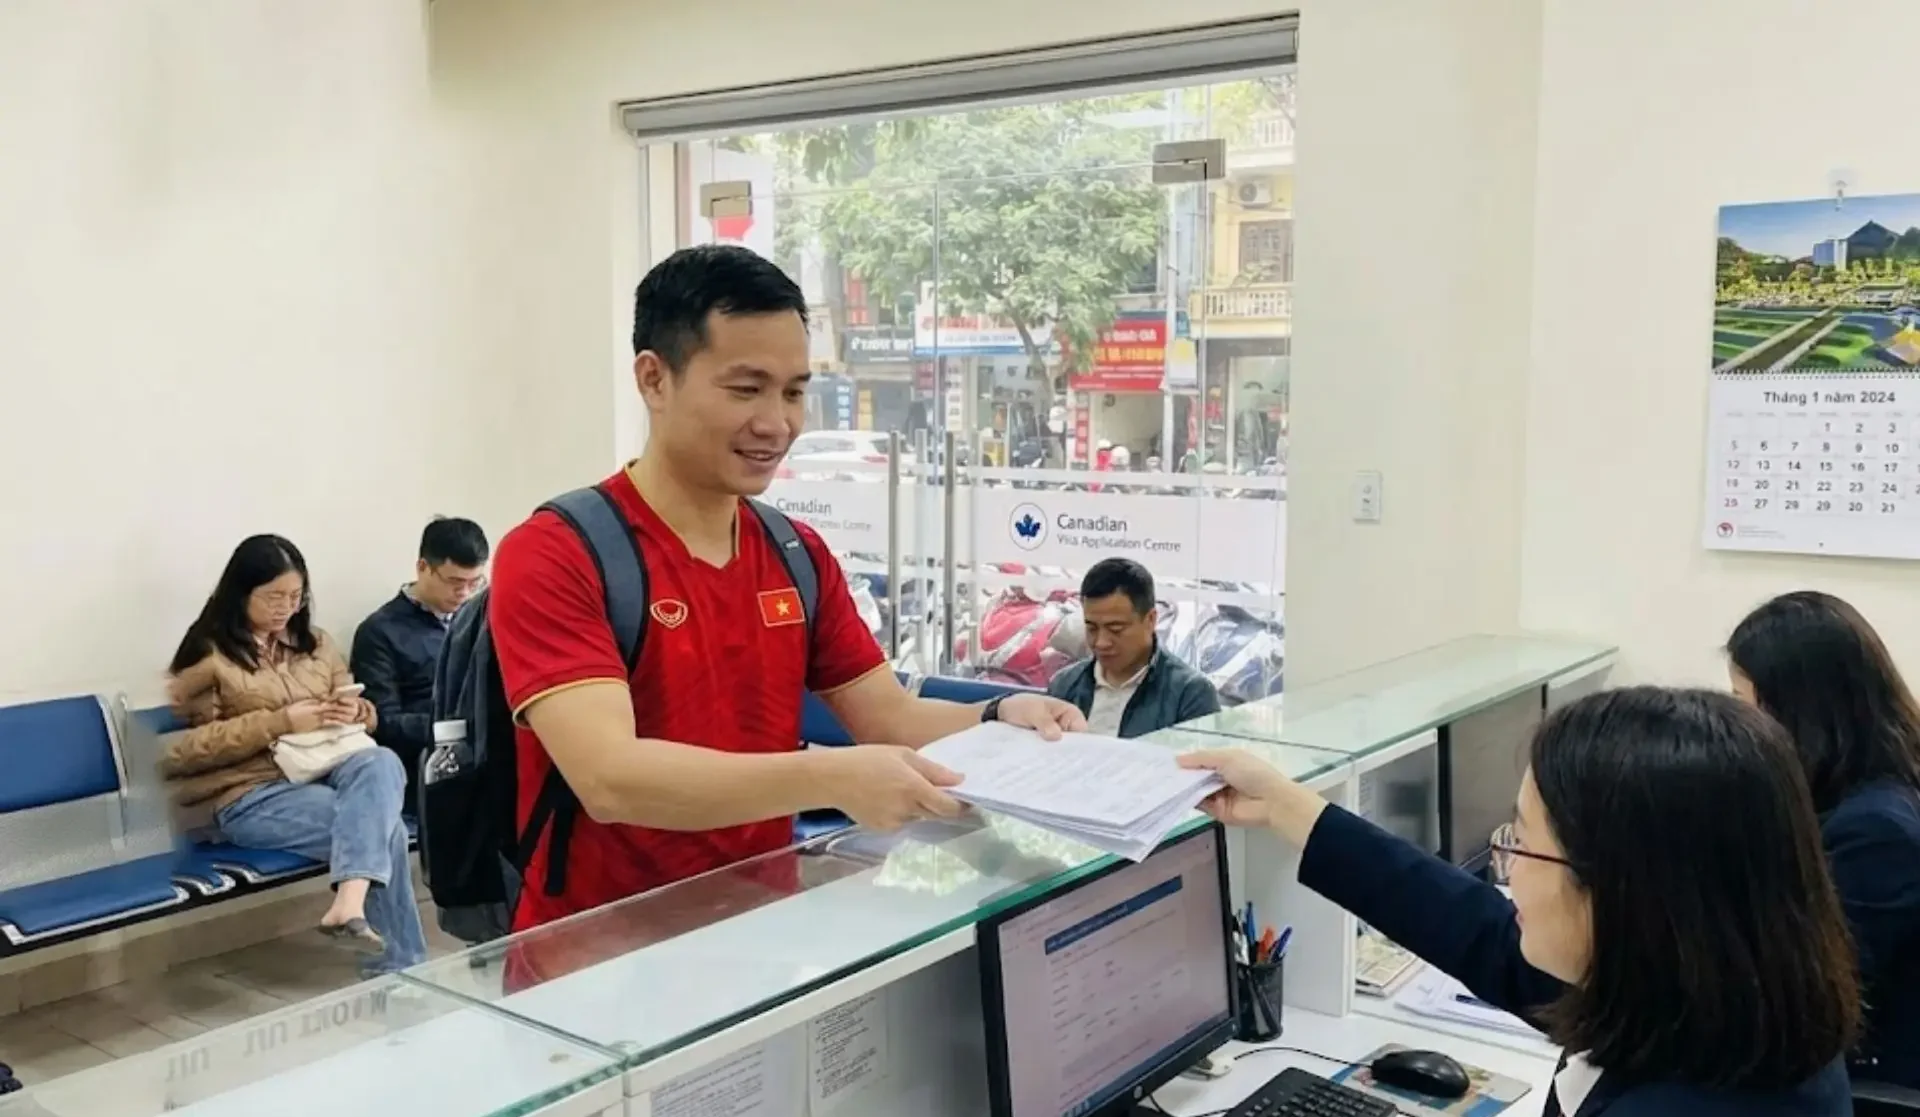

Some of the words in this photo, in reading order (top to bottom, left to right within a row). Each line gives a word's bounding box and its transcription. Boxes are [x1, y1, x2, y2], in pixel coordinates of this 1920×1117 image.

[1813, 391, 1819, 404] 1
[1860, 391, 1896, 404] 2024
[1824, 422, 1831, 432] 1
[1855, 422, 1864, 434] 2
[1760, 441, 1768, 451] 6
[1791, 441, 1799, 451] 7
[1885, 443, 1900, 454] 10
[1757, 459, 1771, 470] 13
[1788, 461, 1801, 470] 14
[1884, 462, 1898, 472] 17
[1754, 479, 1770, 490] 20
[1786, 480, 1799, 491] 21
[1816, 481, 1832, 492] 22
[1849, 482, 1864, 493] 23
[1881, 482, 1897, 494] 24
[1754, 498, 1769, 509] 27
[1057, 514, 1127, 532] Canadian
[1143, 538, 1181, 552] Centre
